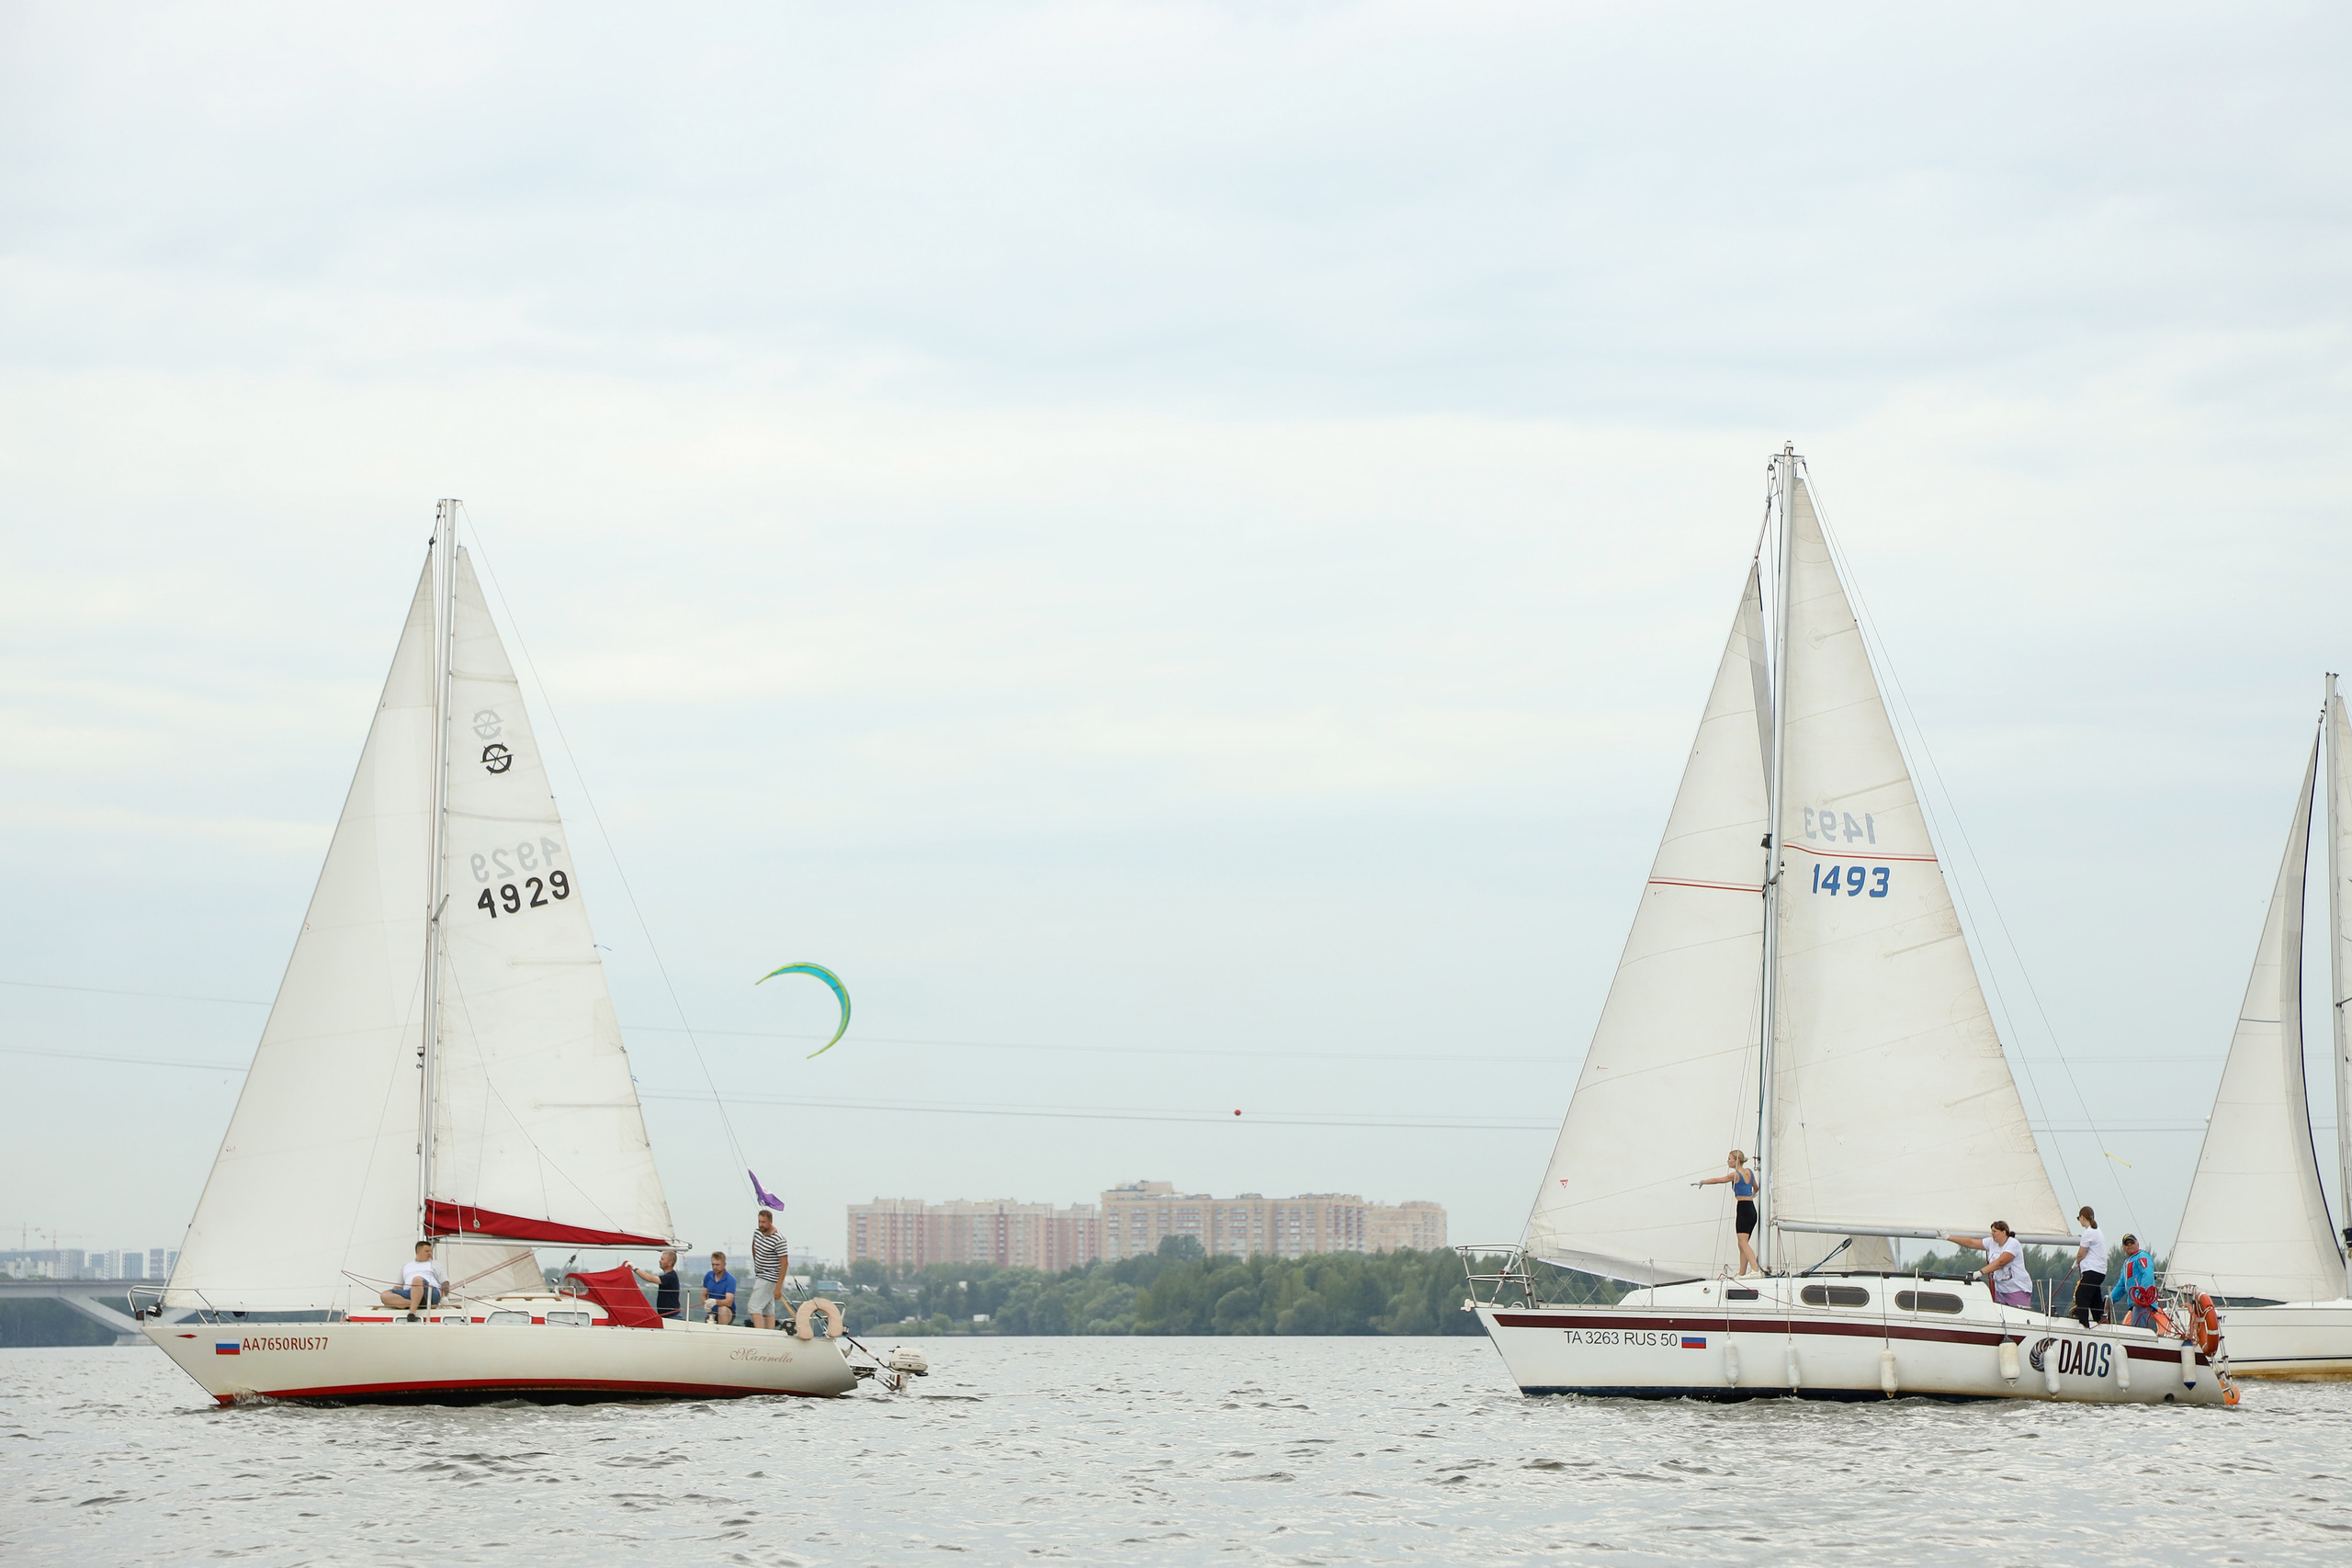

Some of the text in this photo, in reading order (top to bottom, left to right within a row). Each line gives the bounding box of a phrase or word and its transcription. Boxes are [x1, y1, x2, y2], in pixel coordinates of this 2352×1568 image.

[1813, 863, 1890, 897] 1493
[478, 870, 570, 919] 4929
[243, 1337, 329, 1351] AA7650RUS77
[1564, 1331, 1678, 1347] TA 3263 RUS 50
[729, 1347, 794, 1363] Marinella
[2058, 1339, 2111, 1378] DAOS
